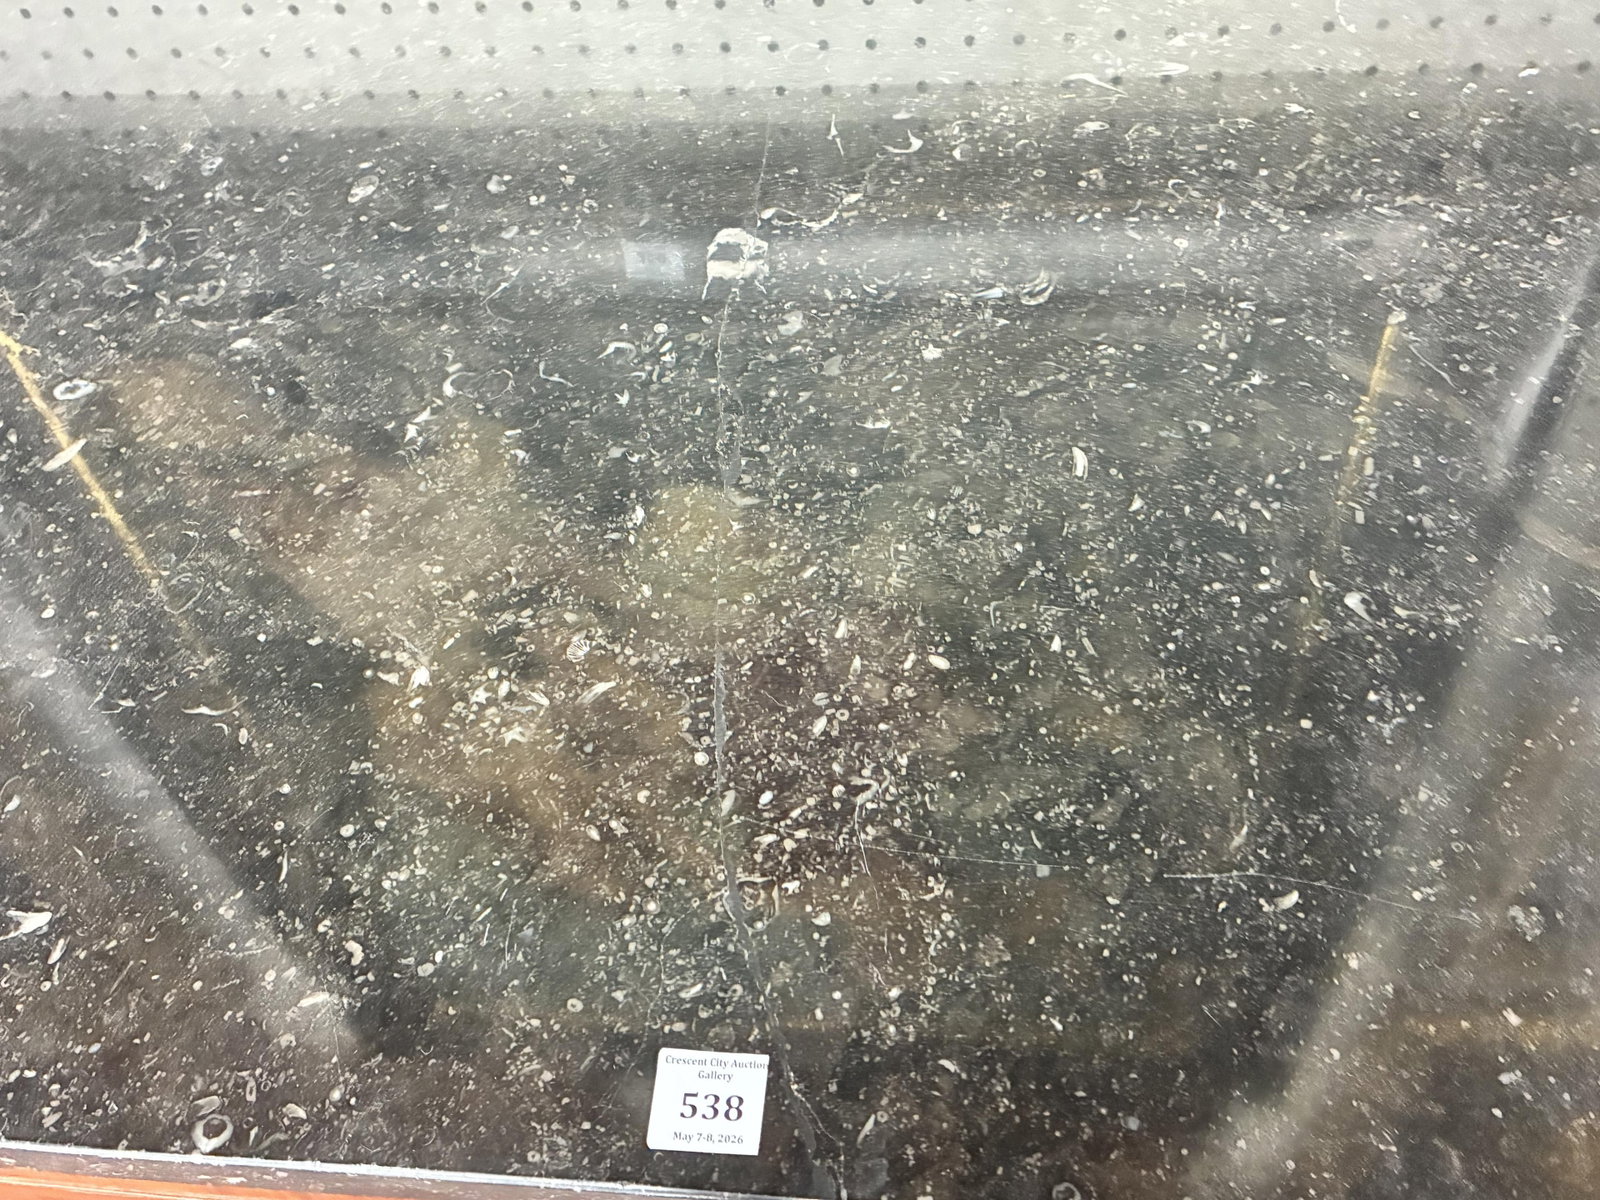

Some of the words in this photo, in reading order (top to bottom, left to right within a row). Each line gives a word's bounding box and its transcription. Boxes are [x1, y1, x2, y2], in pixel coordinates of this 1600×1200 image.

[665, 1055, 707, 1066] Crescent
[710, 1057, 729, 1069] City
[698, 1070, 734, 1083] Gallery
[680, 1092, 744, 1122] 538
[673, 1131, 694, 1143] May
[697, 1132, 715, 1144] 7-8,
[718, 1133, 744, 1144] 2026
